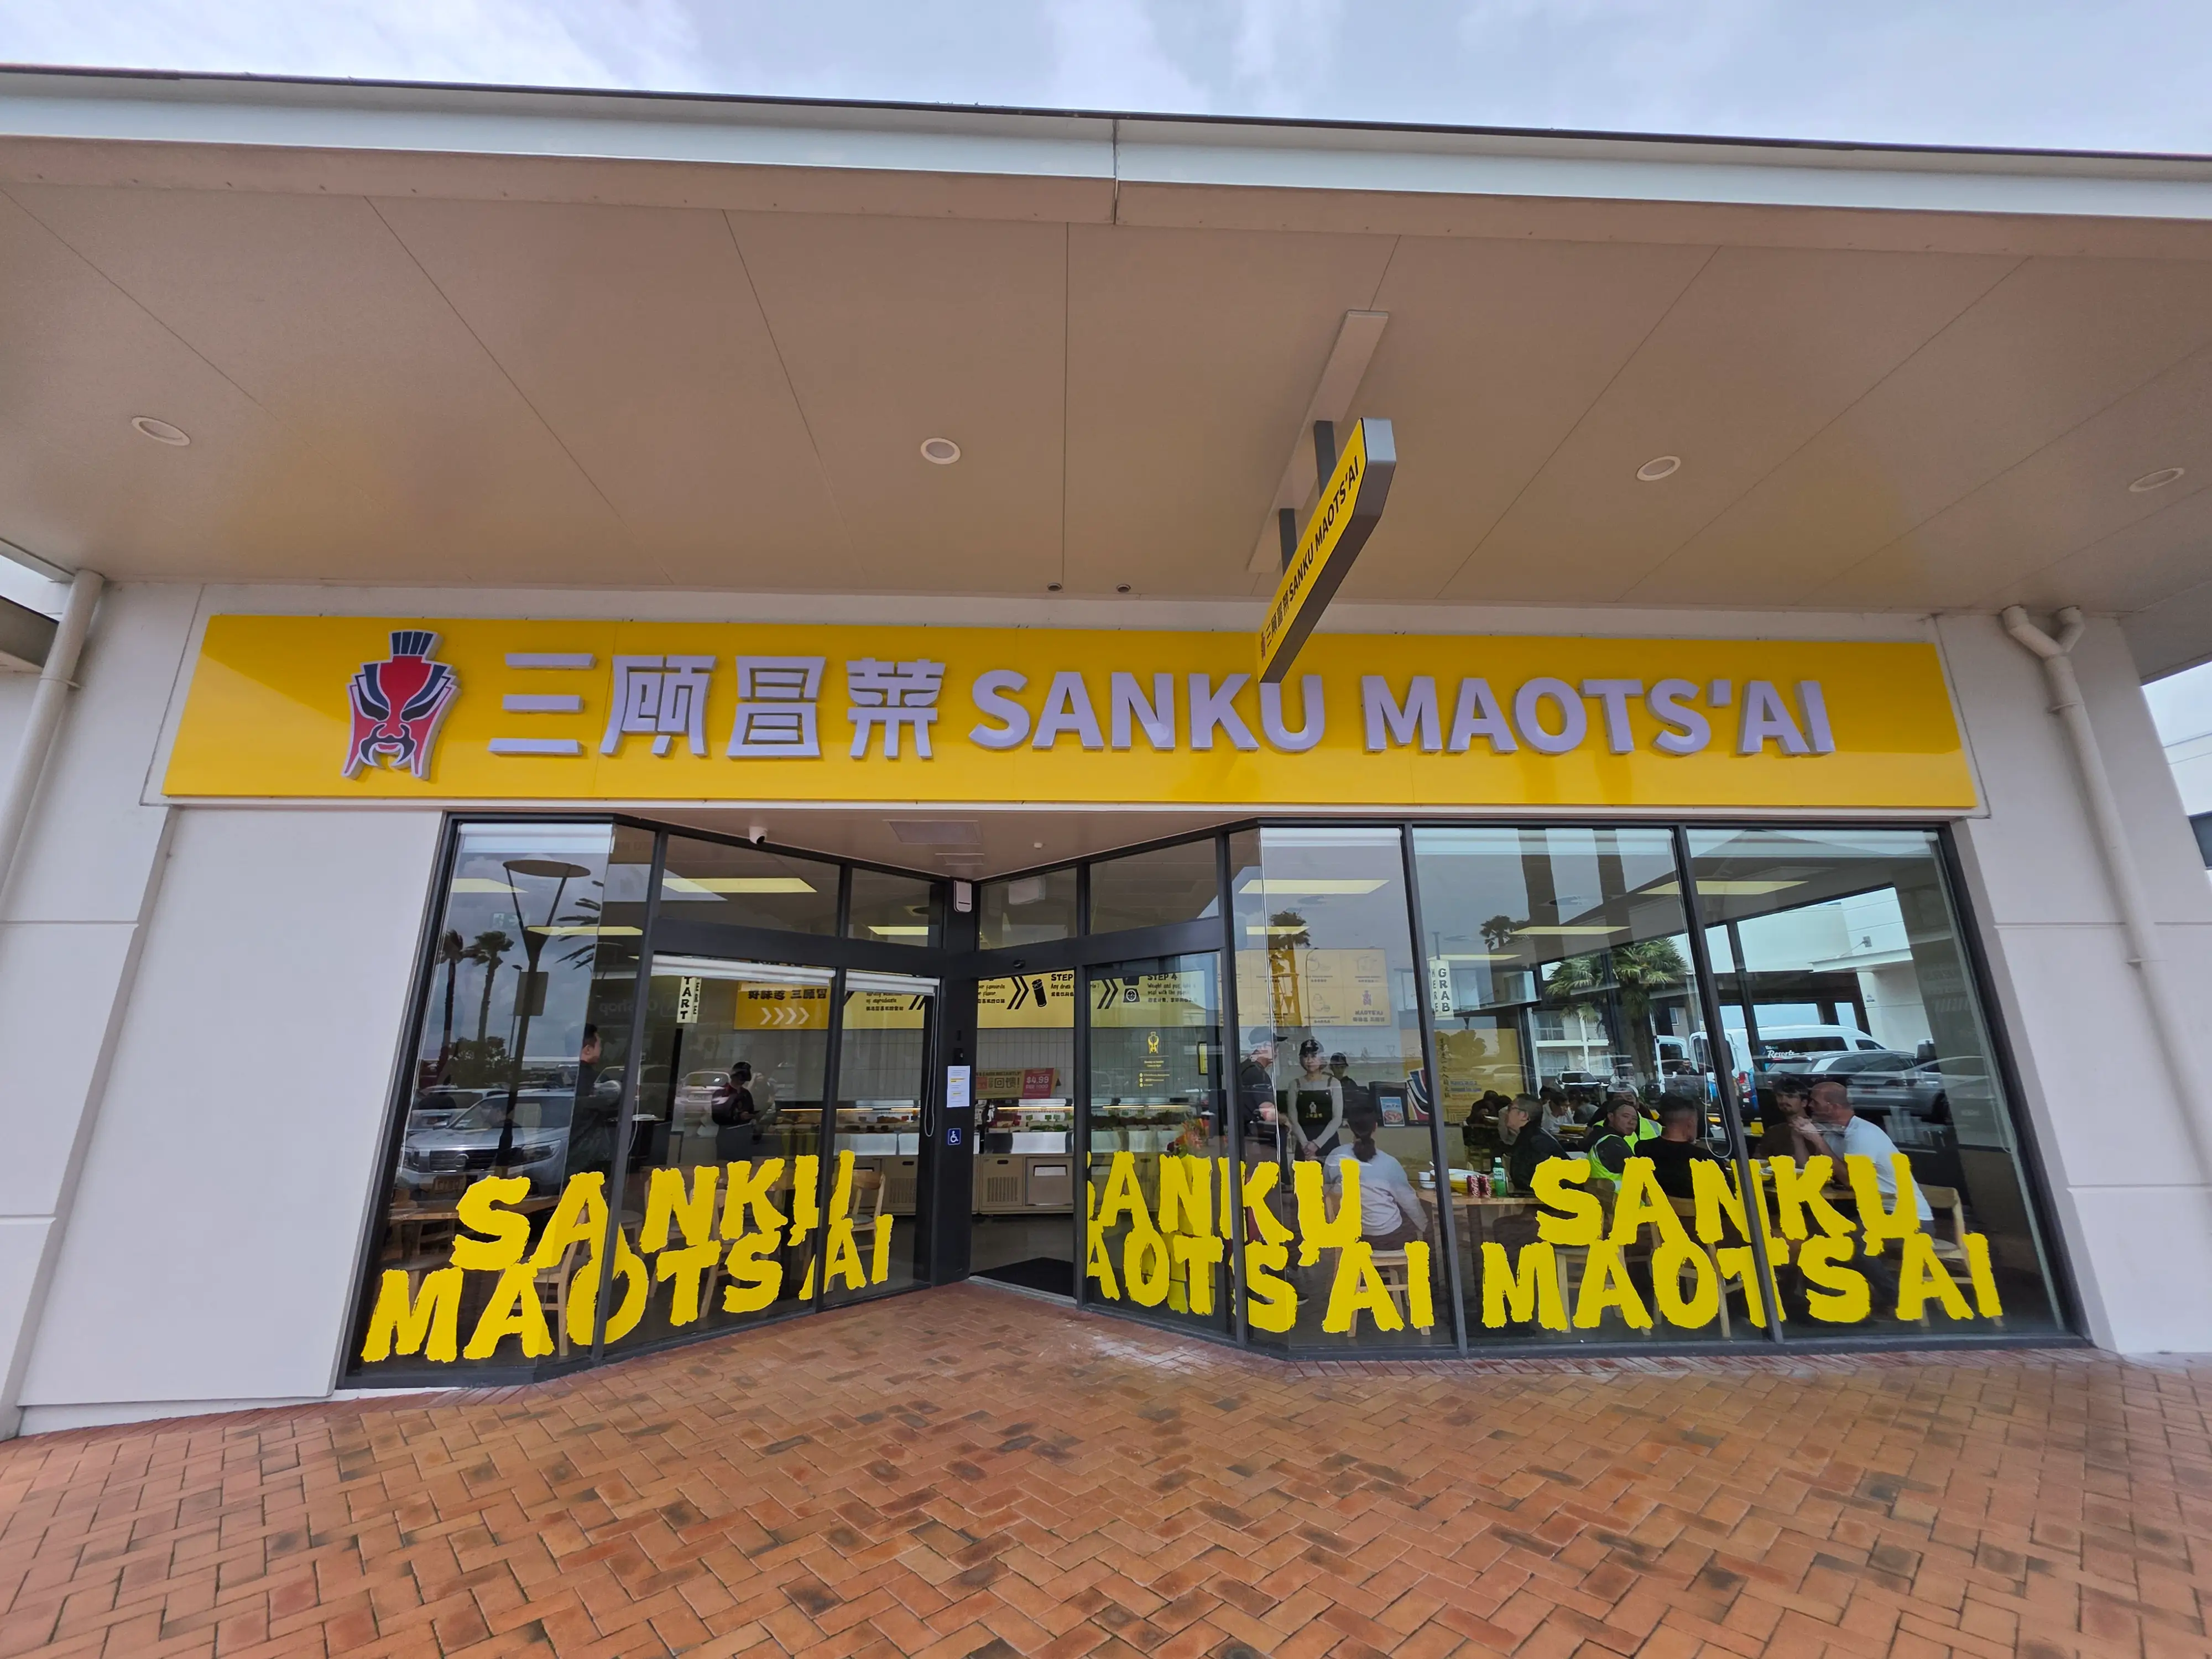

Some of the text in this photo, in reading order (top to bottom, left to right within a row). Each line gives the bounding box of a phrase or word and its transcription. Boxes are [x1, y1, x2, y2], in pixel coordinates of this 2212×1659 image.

[1288, 455, 1359, 602] SANKU MAOTS'AI
[488, 653, 946, 760] 三顾冒菜
[968, 669, 1837, 755] SANKU MAOTS'AI
[680, 977, 692, 1020] TART
[1438, 968, 1451, 1012] GRAB
[449, 1149, 855, 1271] SANKU
[1087, 1151, 1362, 1248] ANKU
[1530, 1152, 1921, 1245] SANKU
[1087, 1219, 1434, 1334] AOTS'AI
[1481, 1232, 2002, 1331] MAOTS'AI
